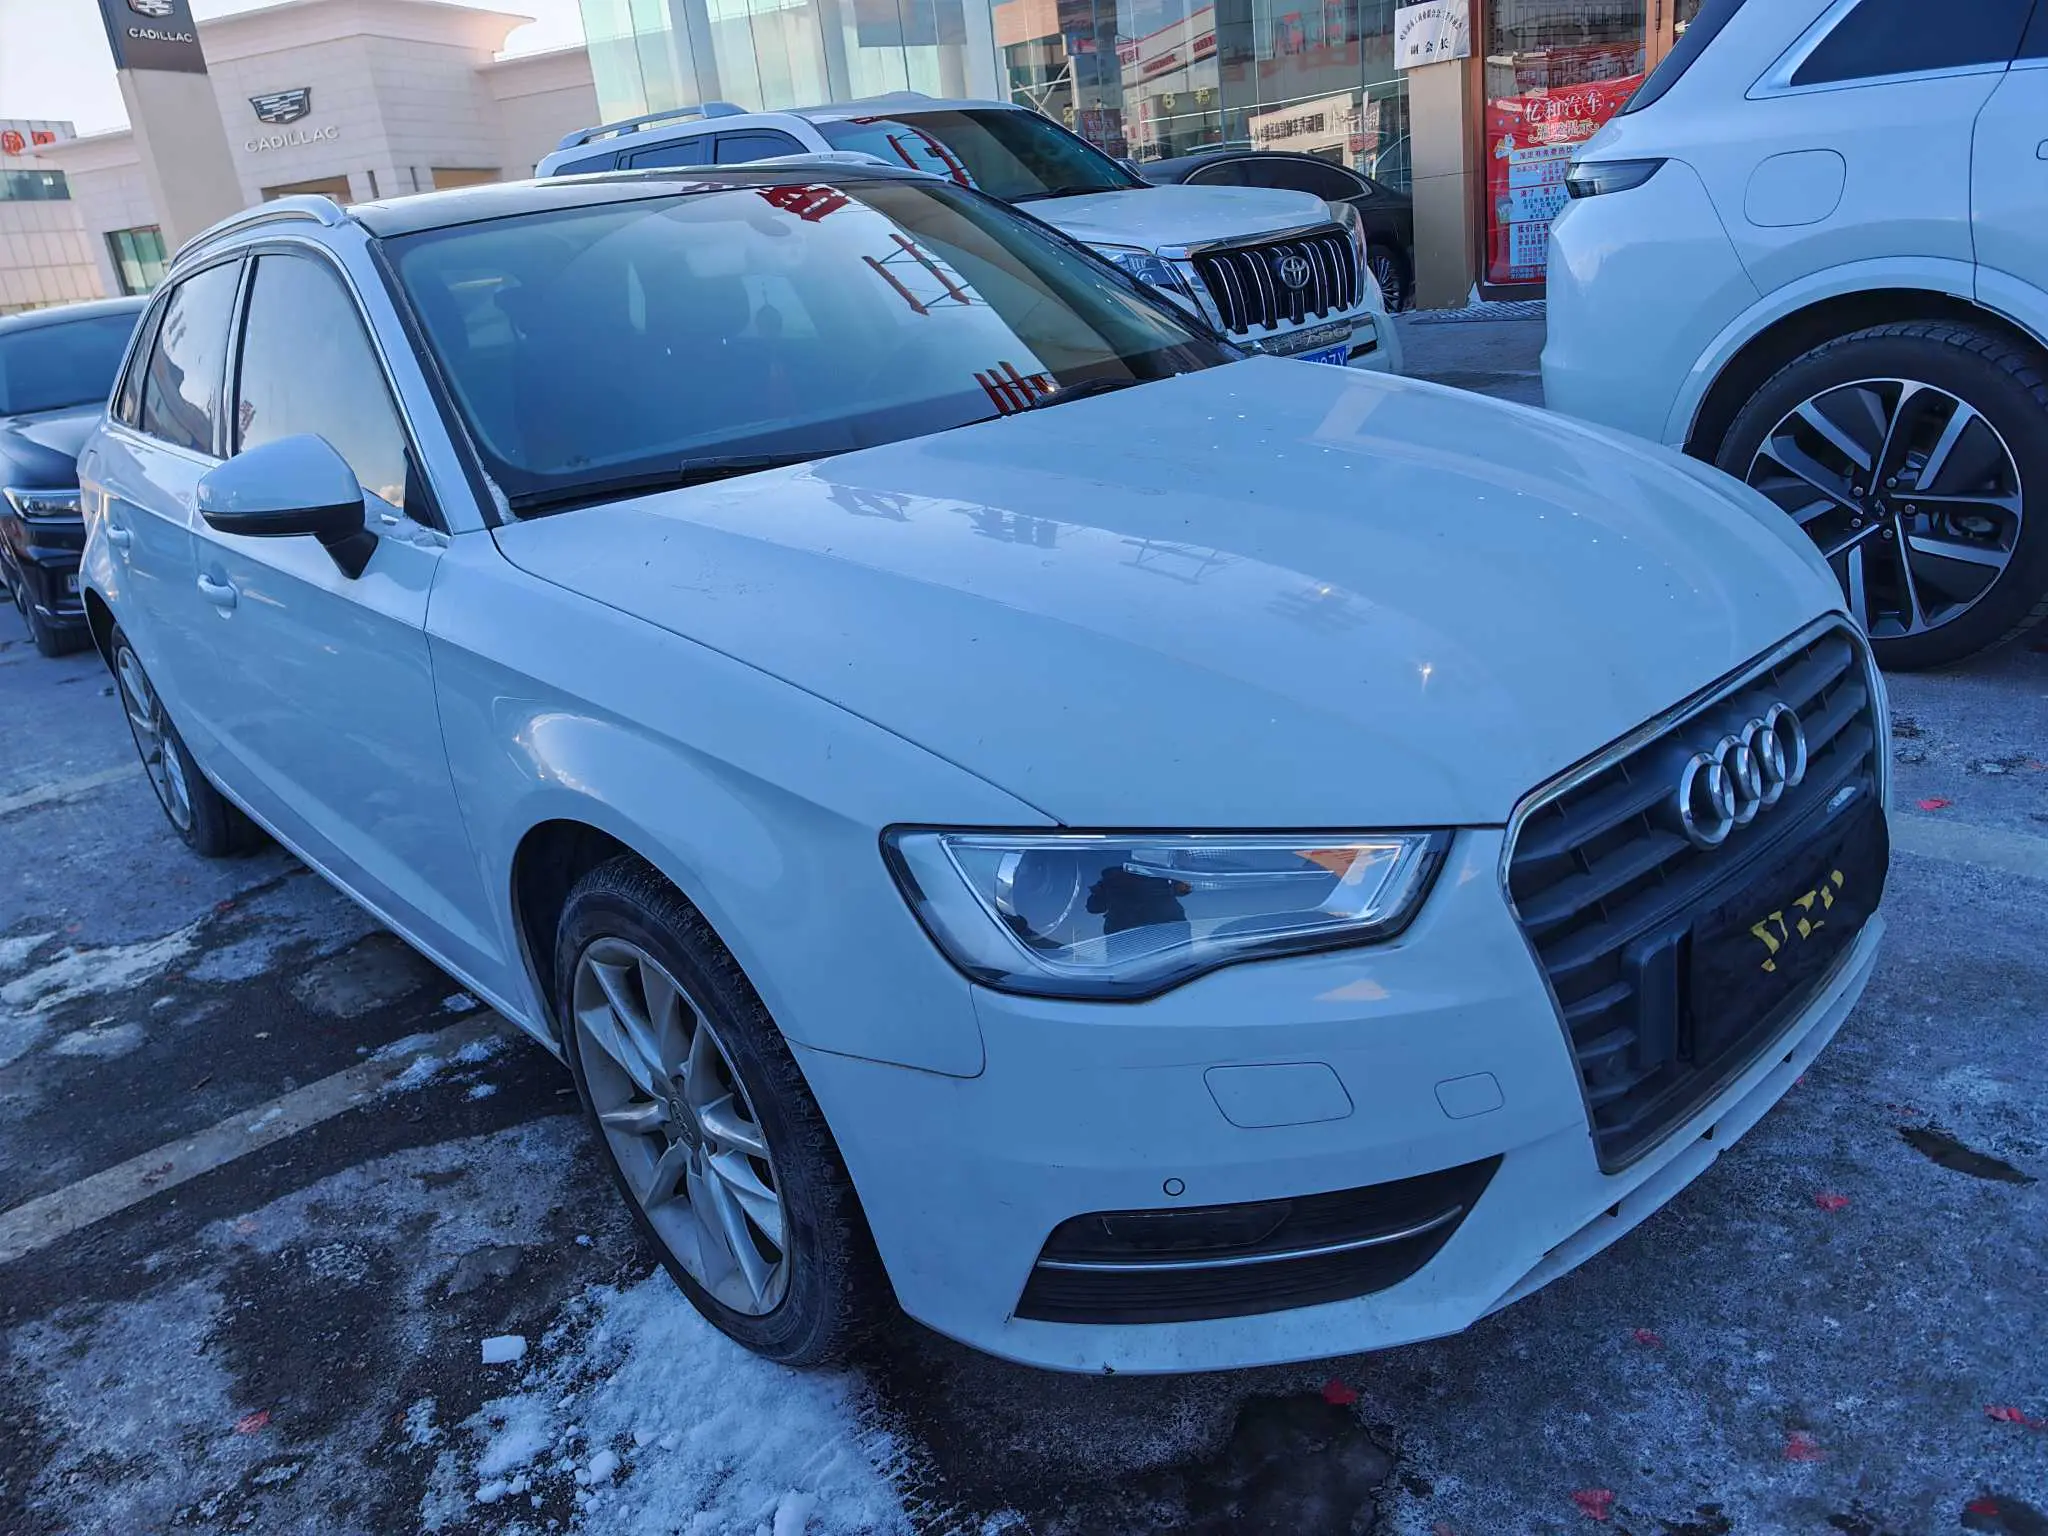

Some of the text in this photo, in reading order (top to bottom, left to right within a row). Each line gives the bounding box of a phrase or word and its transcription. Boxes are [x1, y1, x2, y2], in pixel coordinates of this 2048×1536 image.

[128, 27, 193, 43] CADILLAC
[1410, 37, 1449, 56] 副会长
[1525, 91, 1603, 122] 亿和汽车
[244, 126, 340, 153] CADILLAC
